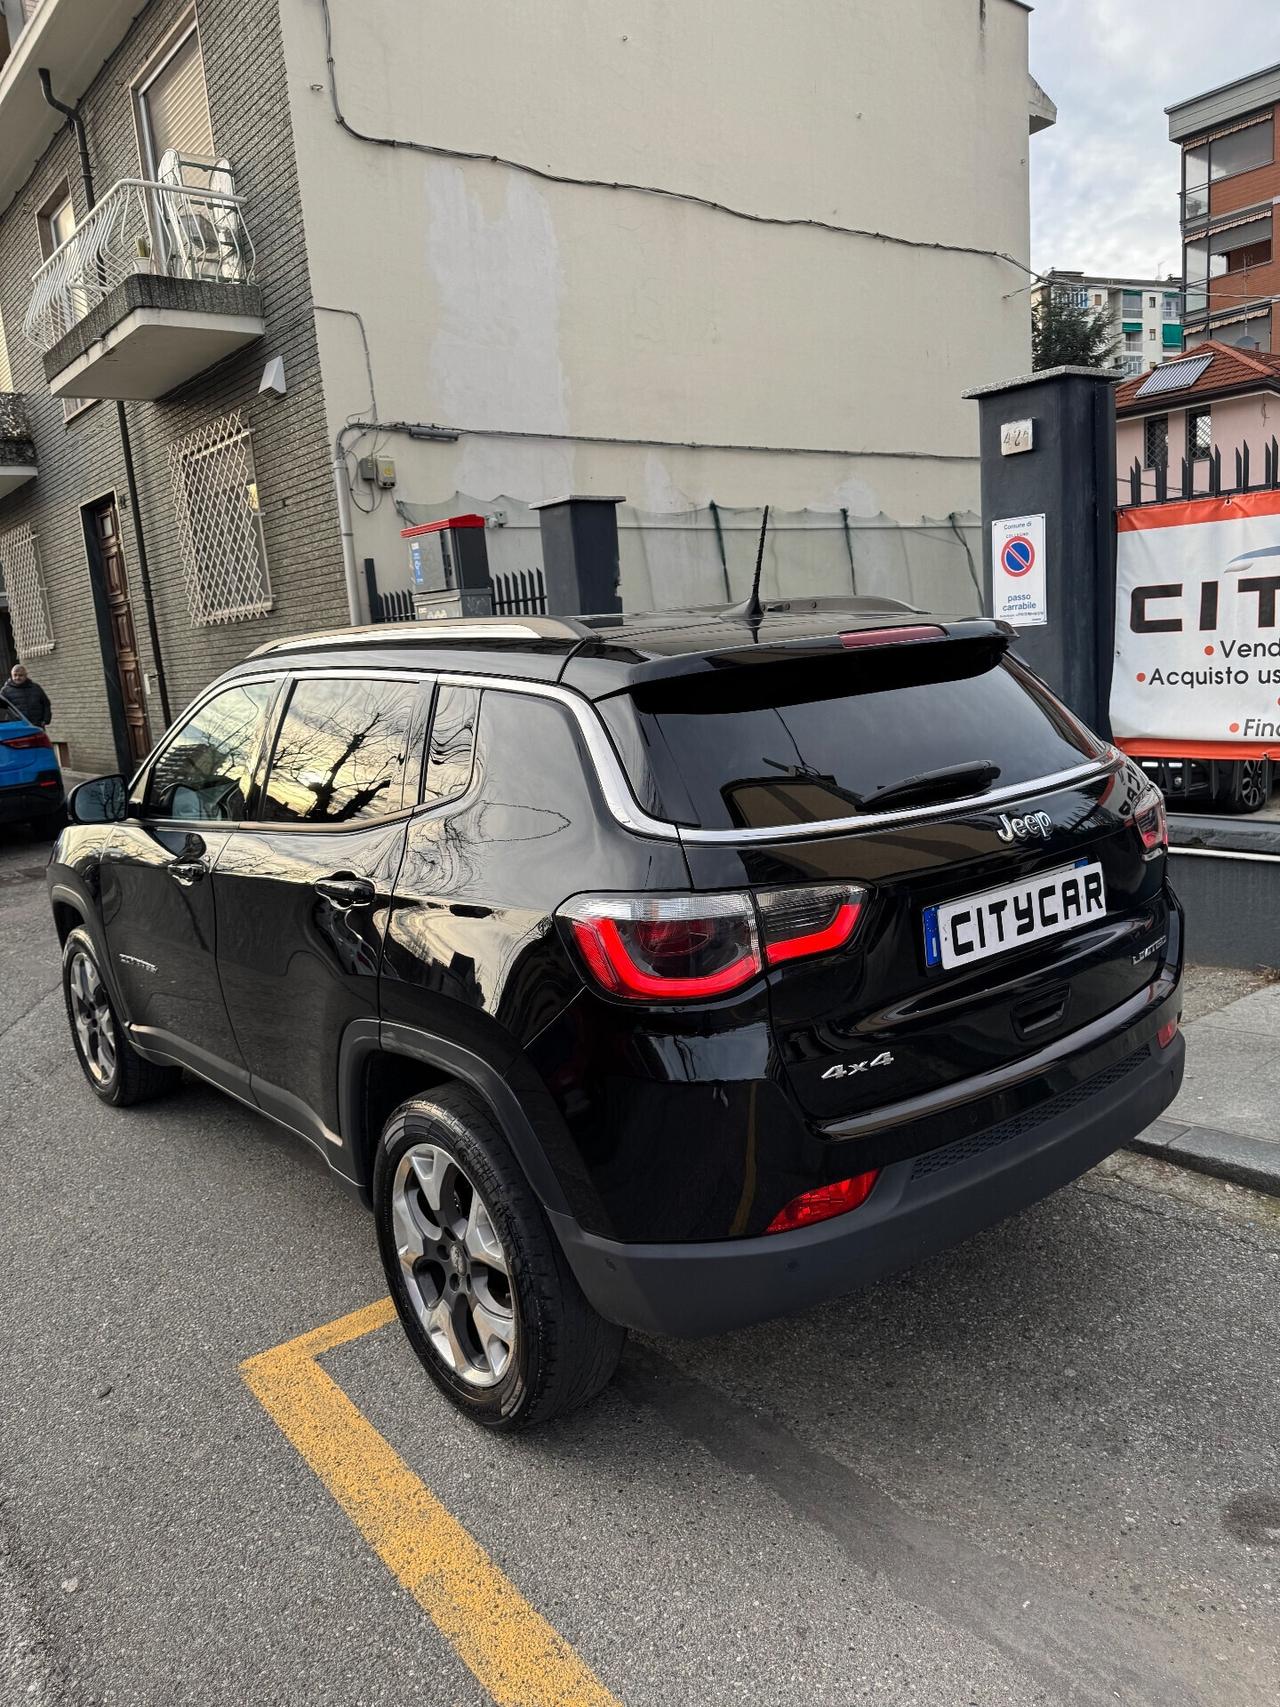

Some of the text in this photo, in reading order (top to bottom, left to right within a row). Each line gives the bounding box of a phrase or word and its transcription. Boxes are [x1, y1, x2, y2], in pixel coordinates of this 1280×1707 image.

[1002, 601, 1037, 611] carrabile
[1007, 594, 1031, 603] passo
[1130, 576, 1280, 634] CIT
[1220, 637, 1280, 658] Vend
[1149, 667, 1249, 689] Acquisto
[996, 810, 1052, 843] Jeep
[950, 871, 1104, 957] CITYCAR
[820, 1051, 895, 1080] 4x4
